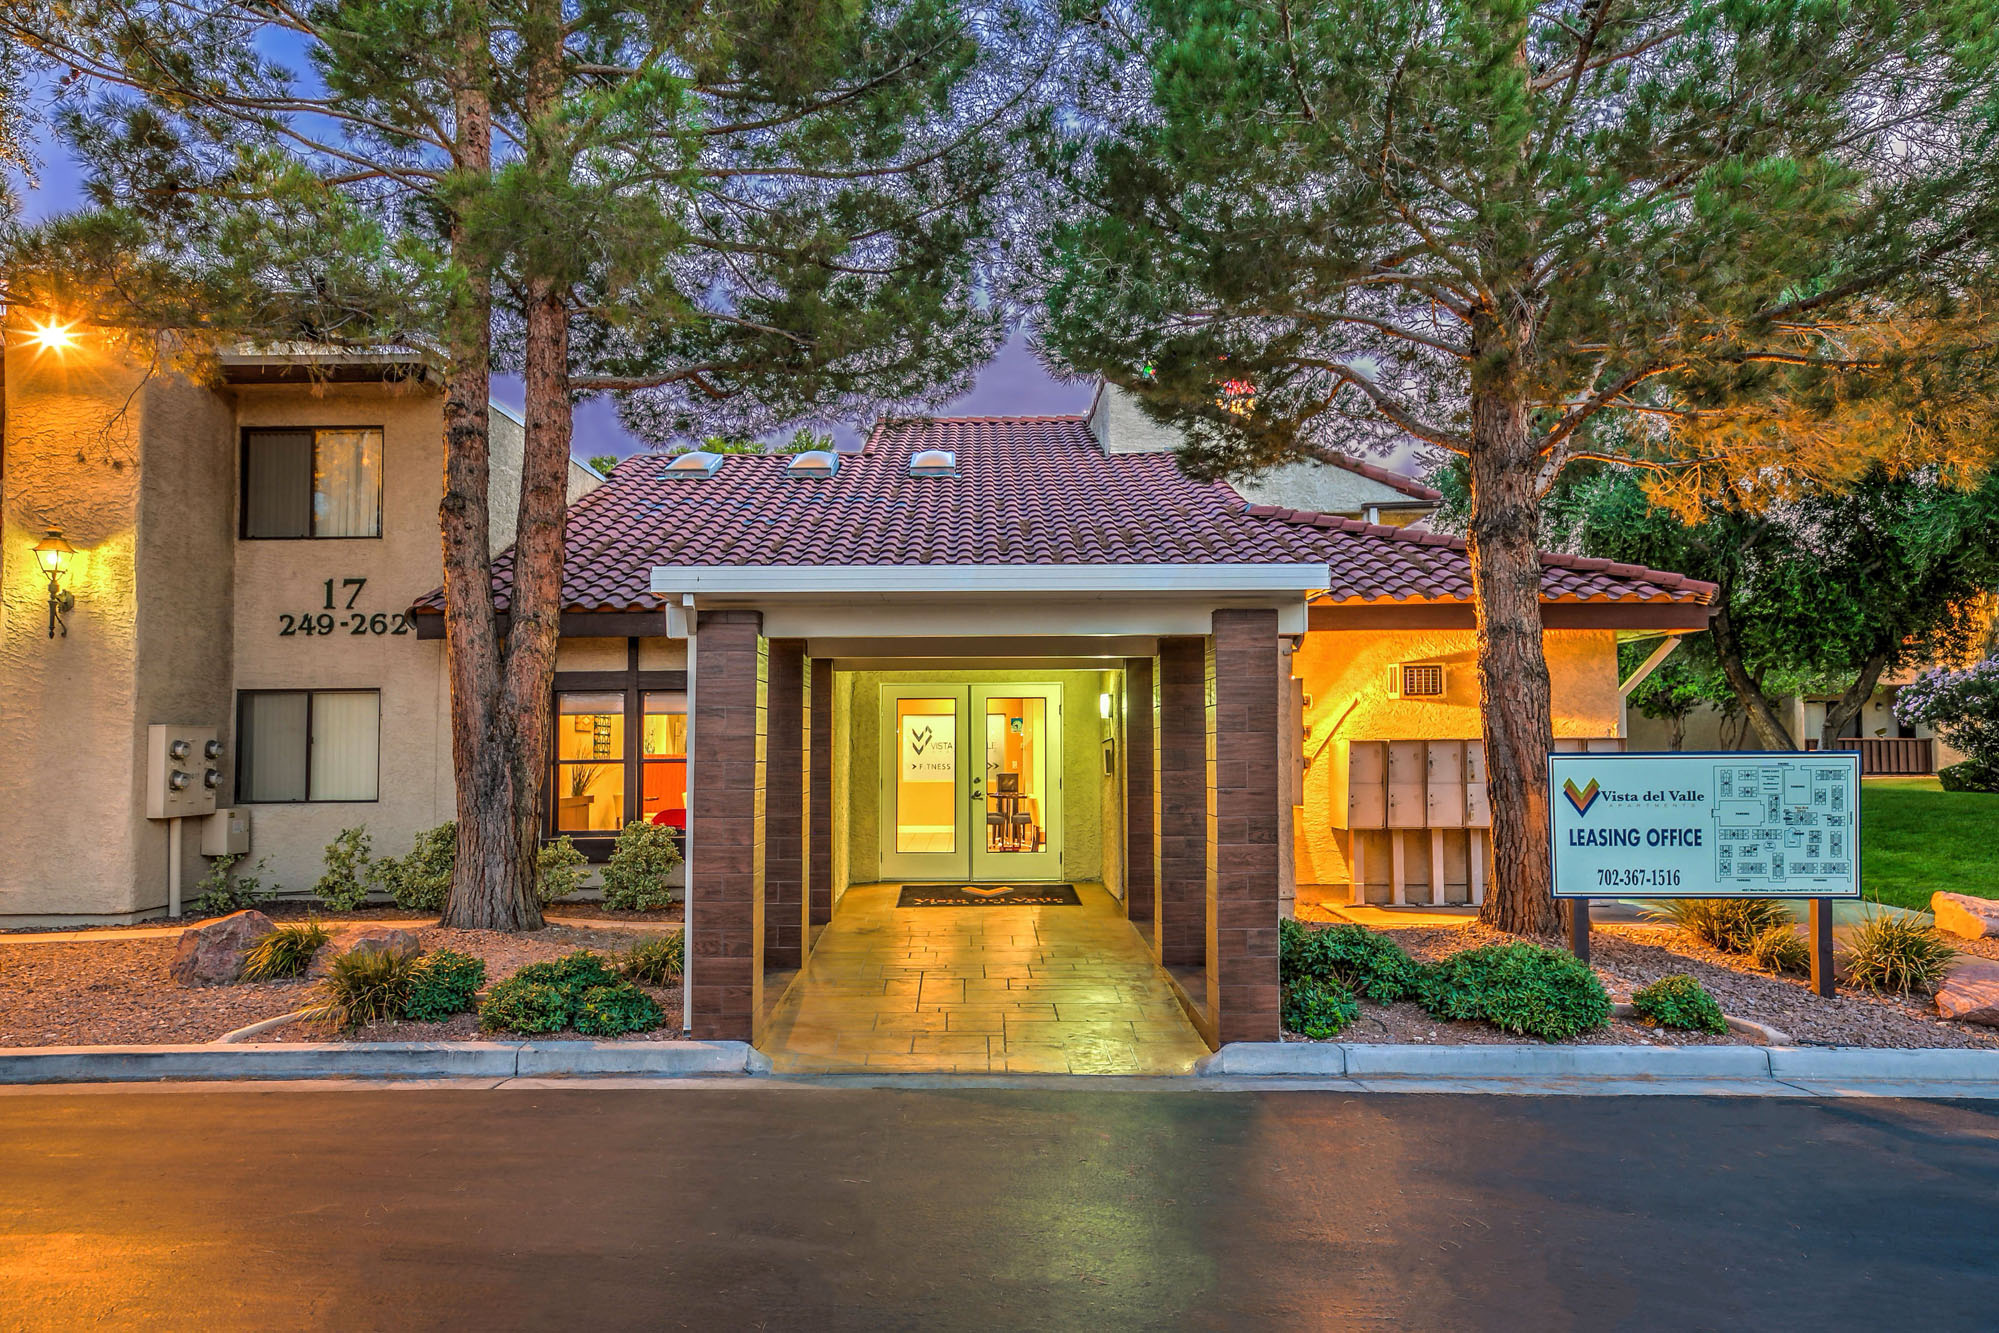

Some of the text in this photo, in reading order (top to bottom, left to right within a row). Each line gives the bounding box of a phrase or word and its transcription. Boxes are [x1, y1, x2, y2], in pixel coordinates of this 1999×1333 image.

[323, 578, 367, 610] 17
[279, 612, 408, 636] 249-262
[930, 742, 953, 750] VISTA
[1601, 790, 1705, 802] Vista del Valle
[1569, 828, 1703, 847] LEASING OFFICE
[1597, 869, 1681, 886] 702-367-1516
